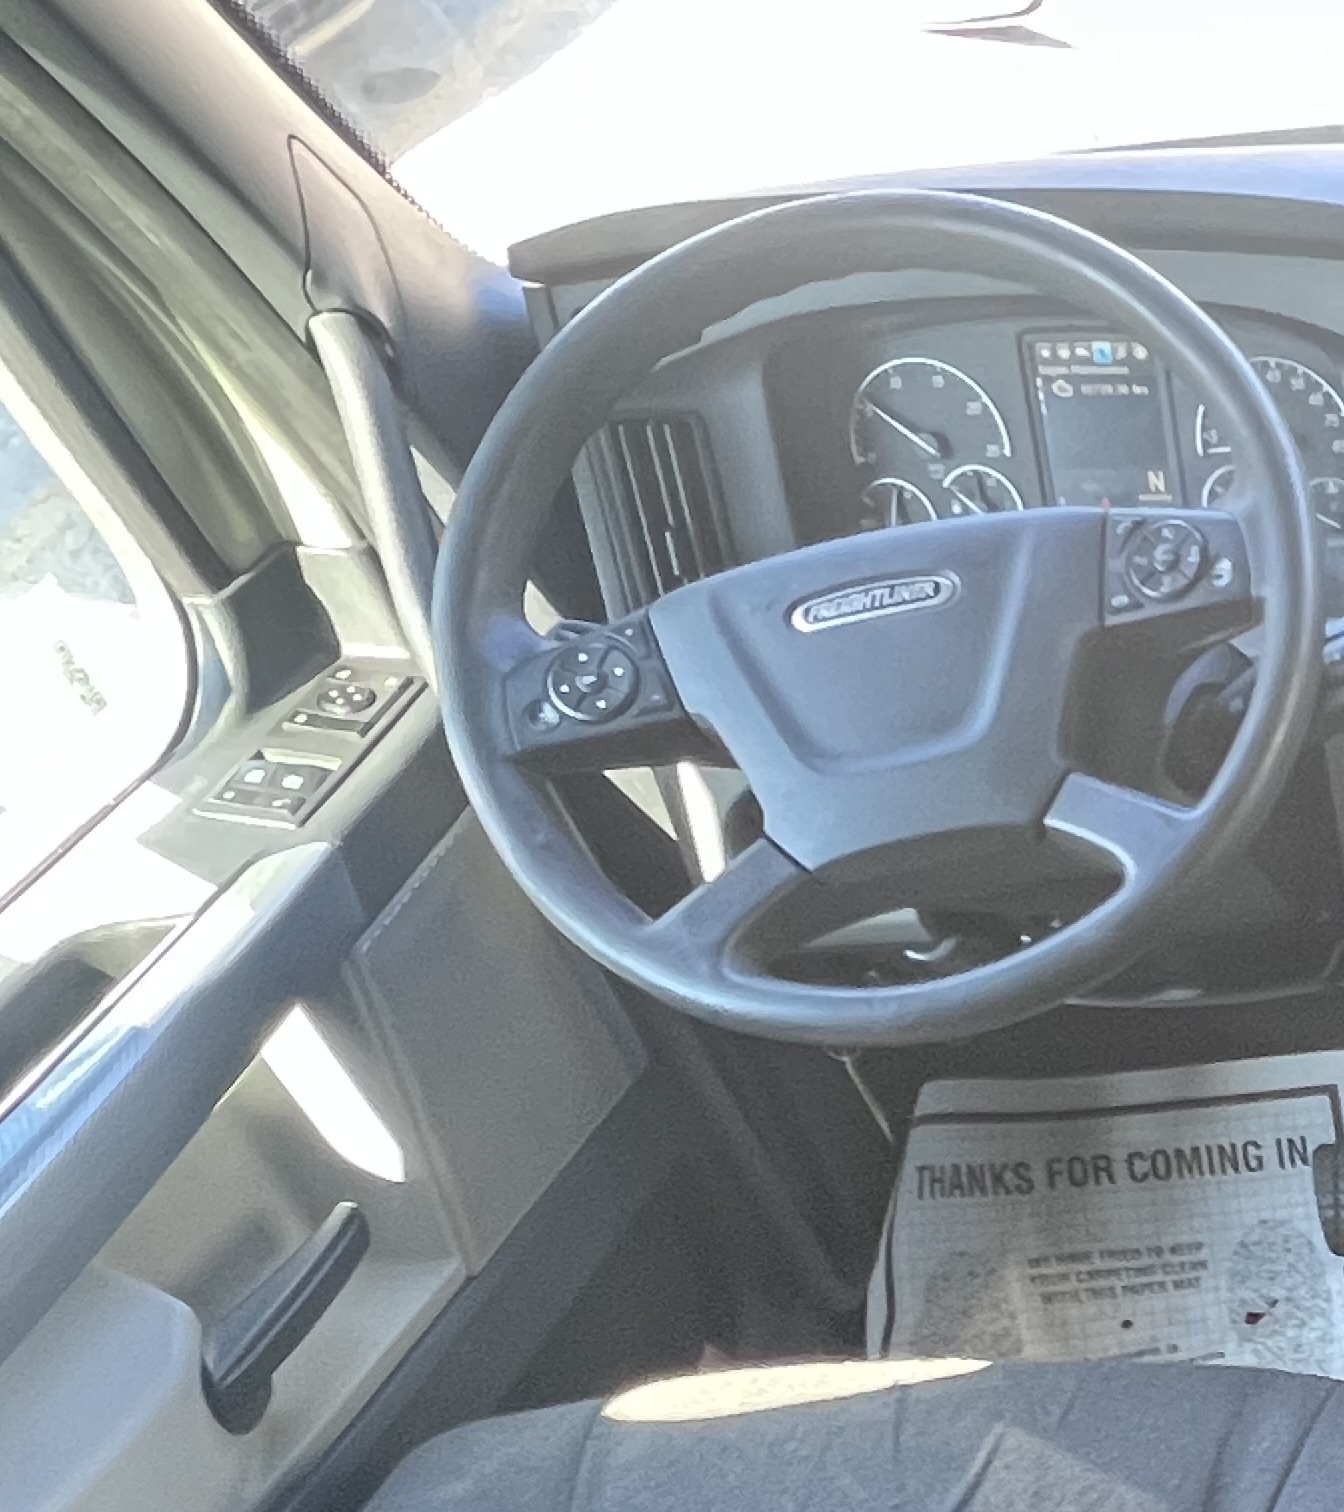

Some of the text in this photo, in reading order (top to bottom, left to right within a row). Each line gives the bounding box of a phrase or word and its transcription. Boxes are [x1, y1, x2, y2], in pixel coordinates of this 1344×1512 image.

[1147, 470, 1166, 493] N
[807, 581, 937, 624] FREIGHTLINER
[915, 1135, 1310, 1200] THANKS FOR COMING IN
